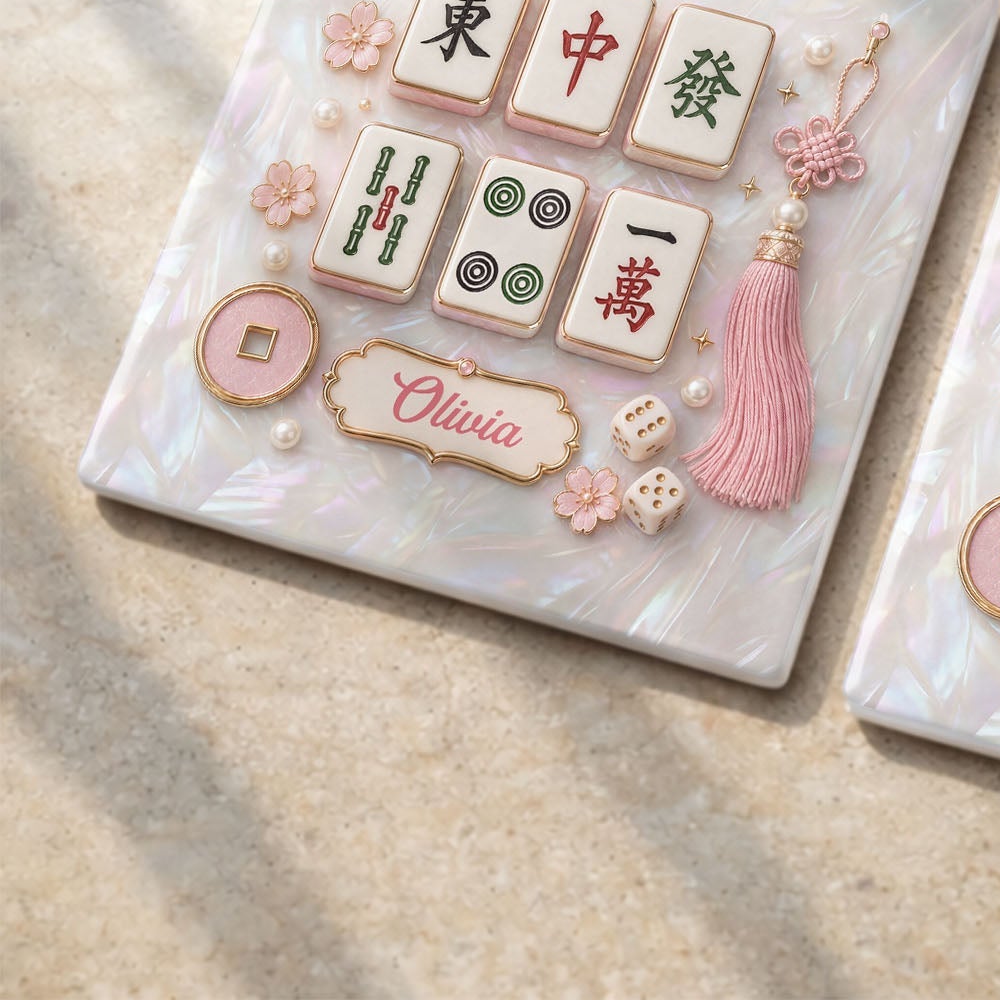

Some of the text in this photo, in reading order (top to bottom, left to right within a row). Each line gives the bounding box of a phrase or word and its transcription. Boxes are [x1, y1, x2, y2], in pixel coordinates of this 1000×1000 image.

[562, 10, 620, 98] 中
[663, 48, 742, 130] 發
[393, 372, 523, 448] Olivia
